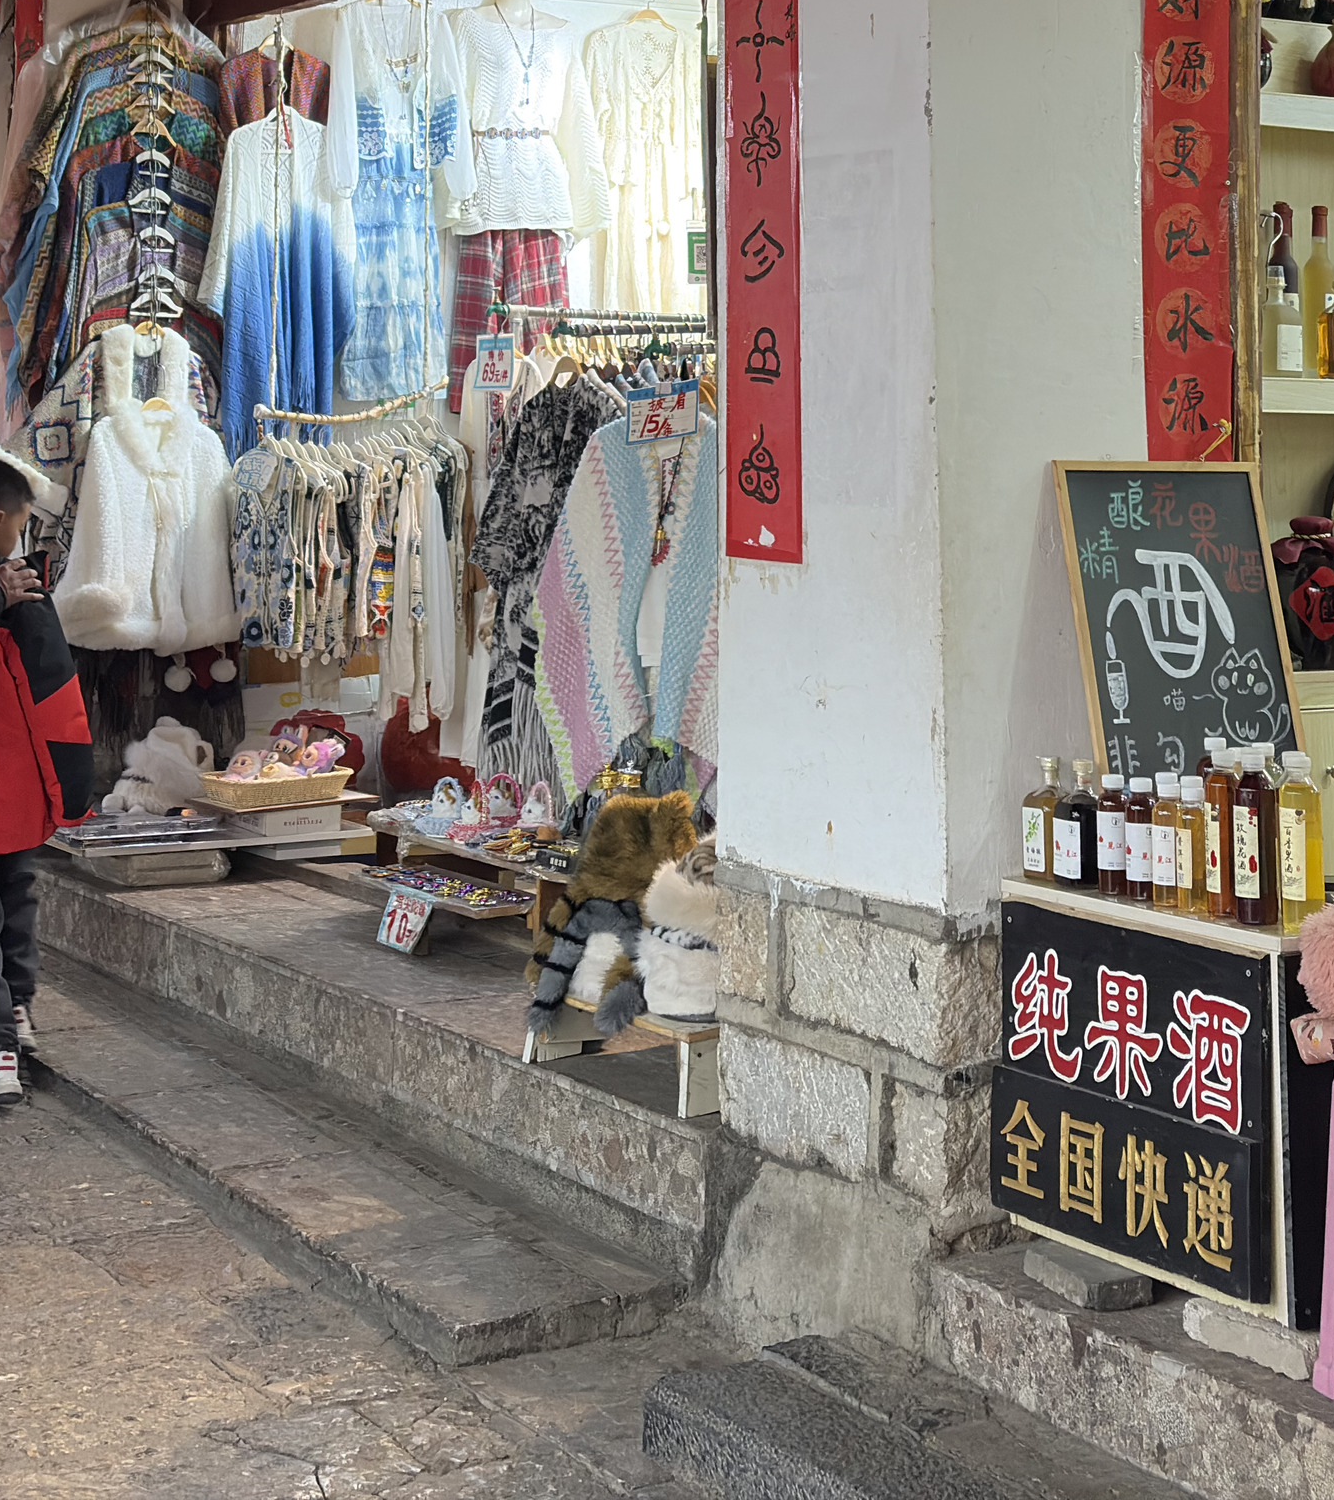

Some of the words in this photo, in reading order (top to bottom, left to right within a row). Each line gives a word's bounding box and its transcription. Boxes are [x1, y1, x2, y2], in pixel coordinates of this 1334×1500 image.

[1108, 728, 1223, 776] 非勾
[1236, 822, 1248, 872] 玫瑰花酒
[1282, 825, 1294, 874] 百香果酒
[1008, 948, 1252, 1135] 纯果酒
[999, 1099, 1235, 1272] 全国快递
